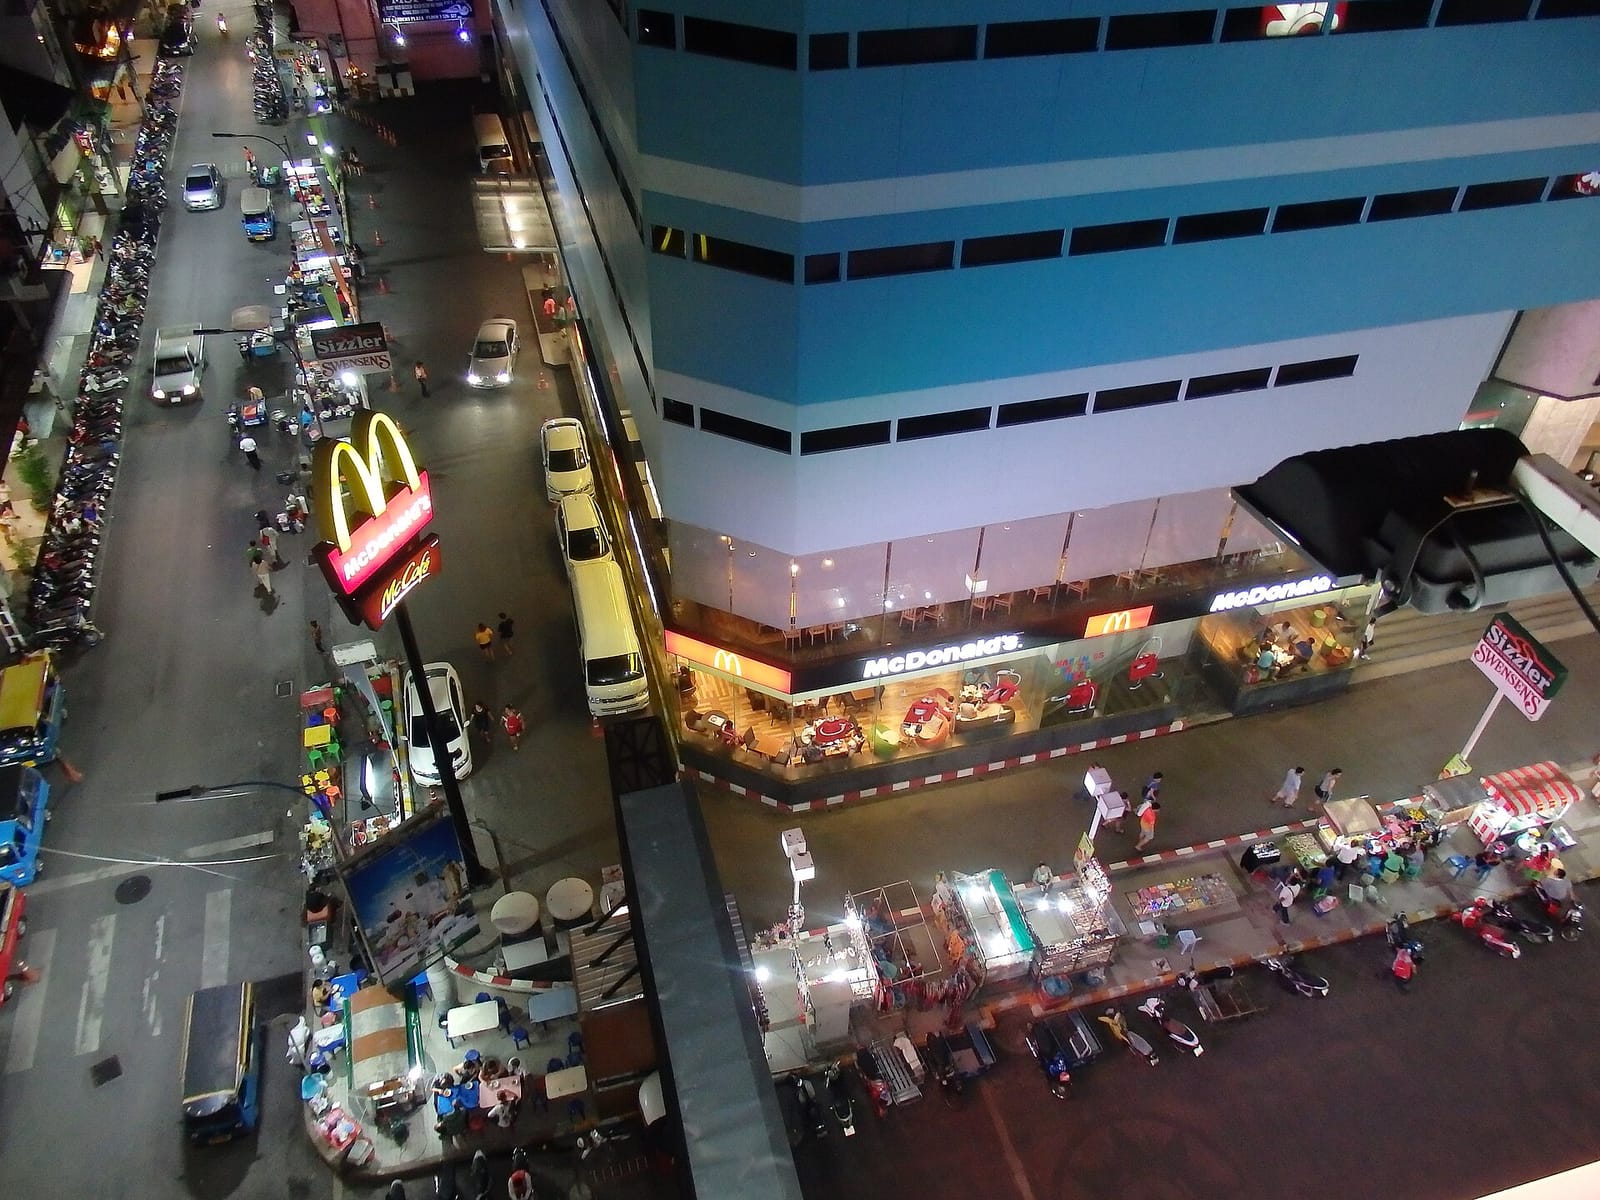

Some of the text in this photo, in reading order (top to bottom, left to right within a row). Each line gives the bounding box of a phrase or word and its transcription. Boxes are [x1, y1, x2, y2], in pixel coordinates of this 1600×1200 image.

[315, 336, 382, 354] Sizzler
[322, 355, 391, 377] SWENSEN'S
[343, 495, 431, 581] McDonald's
[1209, 575, 1340, 613] McDonald
[863, 634, 1020, 679] McDonald's
[1474, 643, 1541, 715] SWENSEN'S
[1486, 624, 1551, 691] Sizzler
